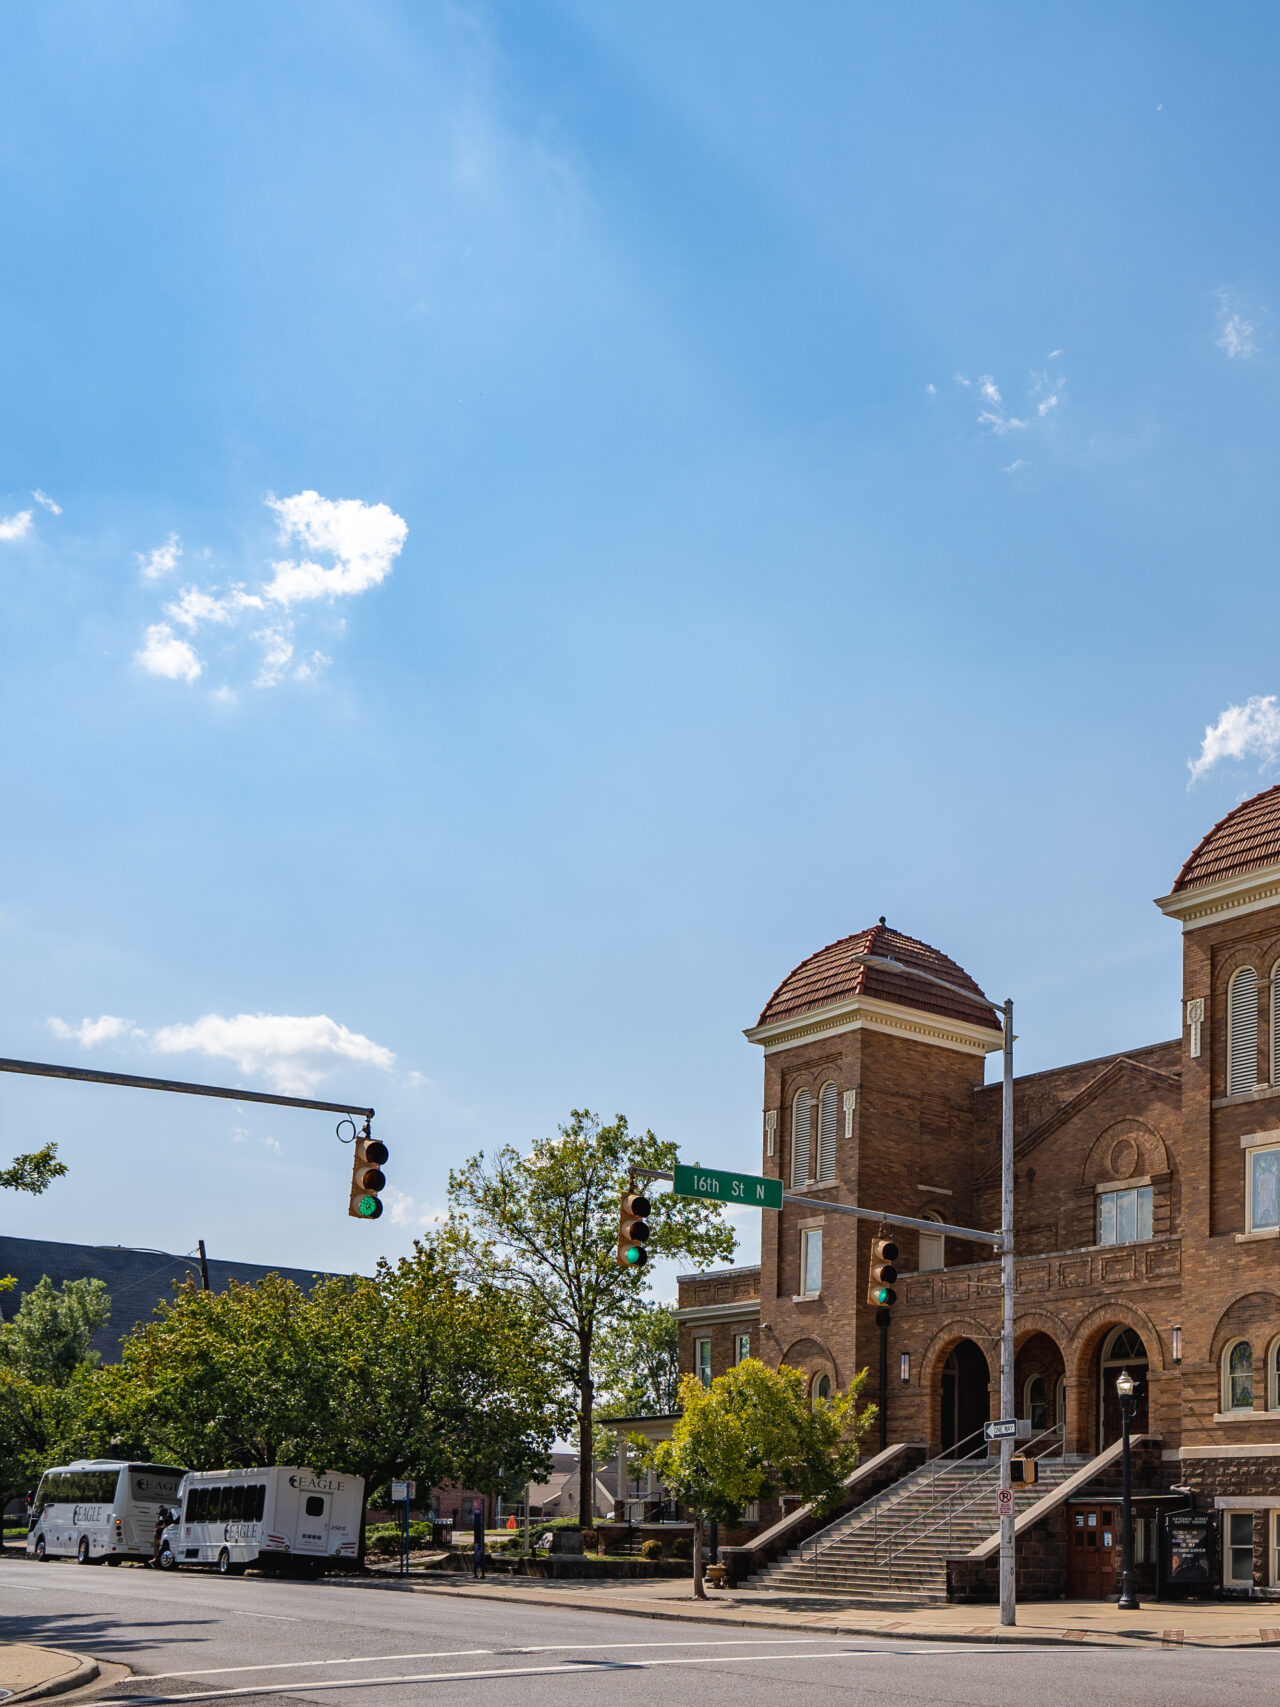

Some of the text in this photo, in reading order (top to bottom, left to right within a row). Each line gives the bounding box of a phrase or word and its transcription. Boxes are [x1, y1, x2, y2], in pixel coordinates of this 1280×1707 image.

[694, 1175, 765, 1200] 16th St N
[994, 1424, 1013, 1434] ONE WAY
[298, 1477, 345, 1491] EAGLE
[77, 1506, 102, 1522] EAGLE
[229, 1524, 258, 1539] EAGLE
